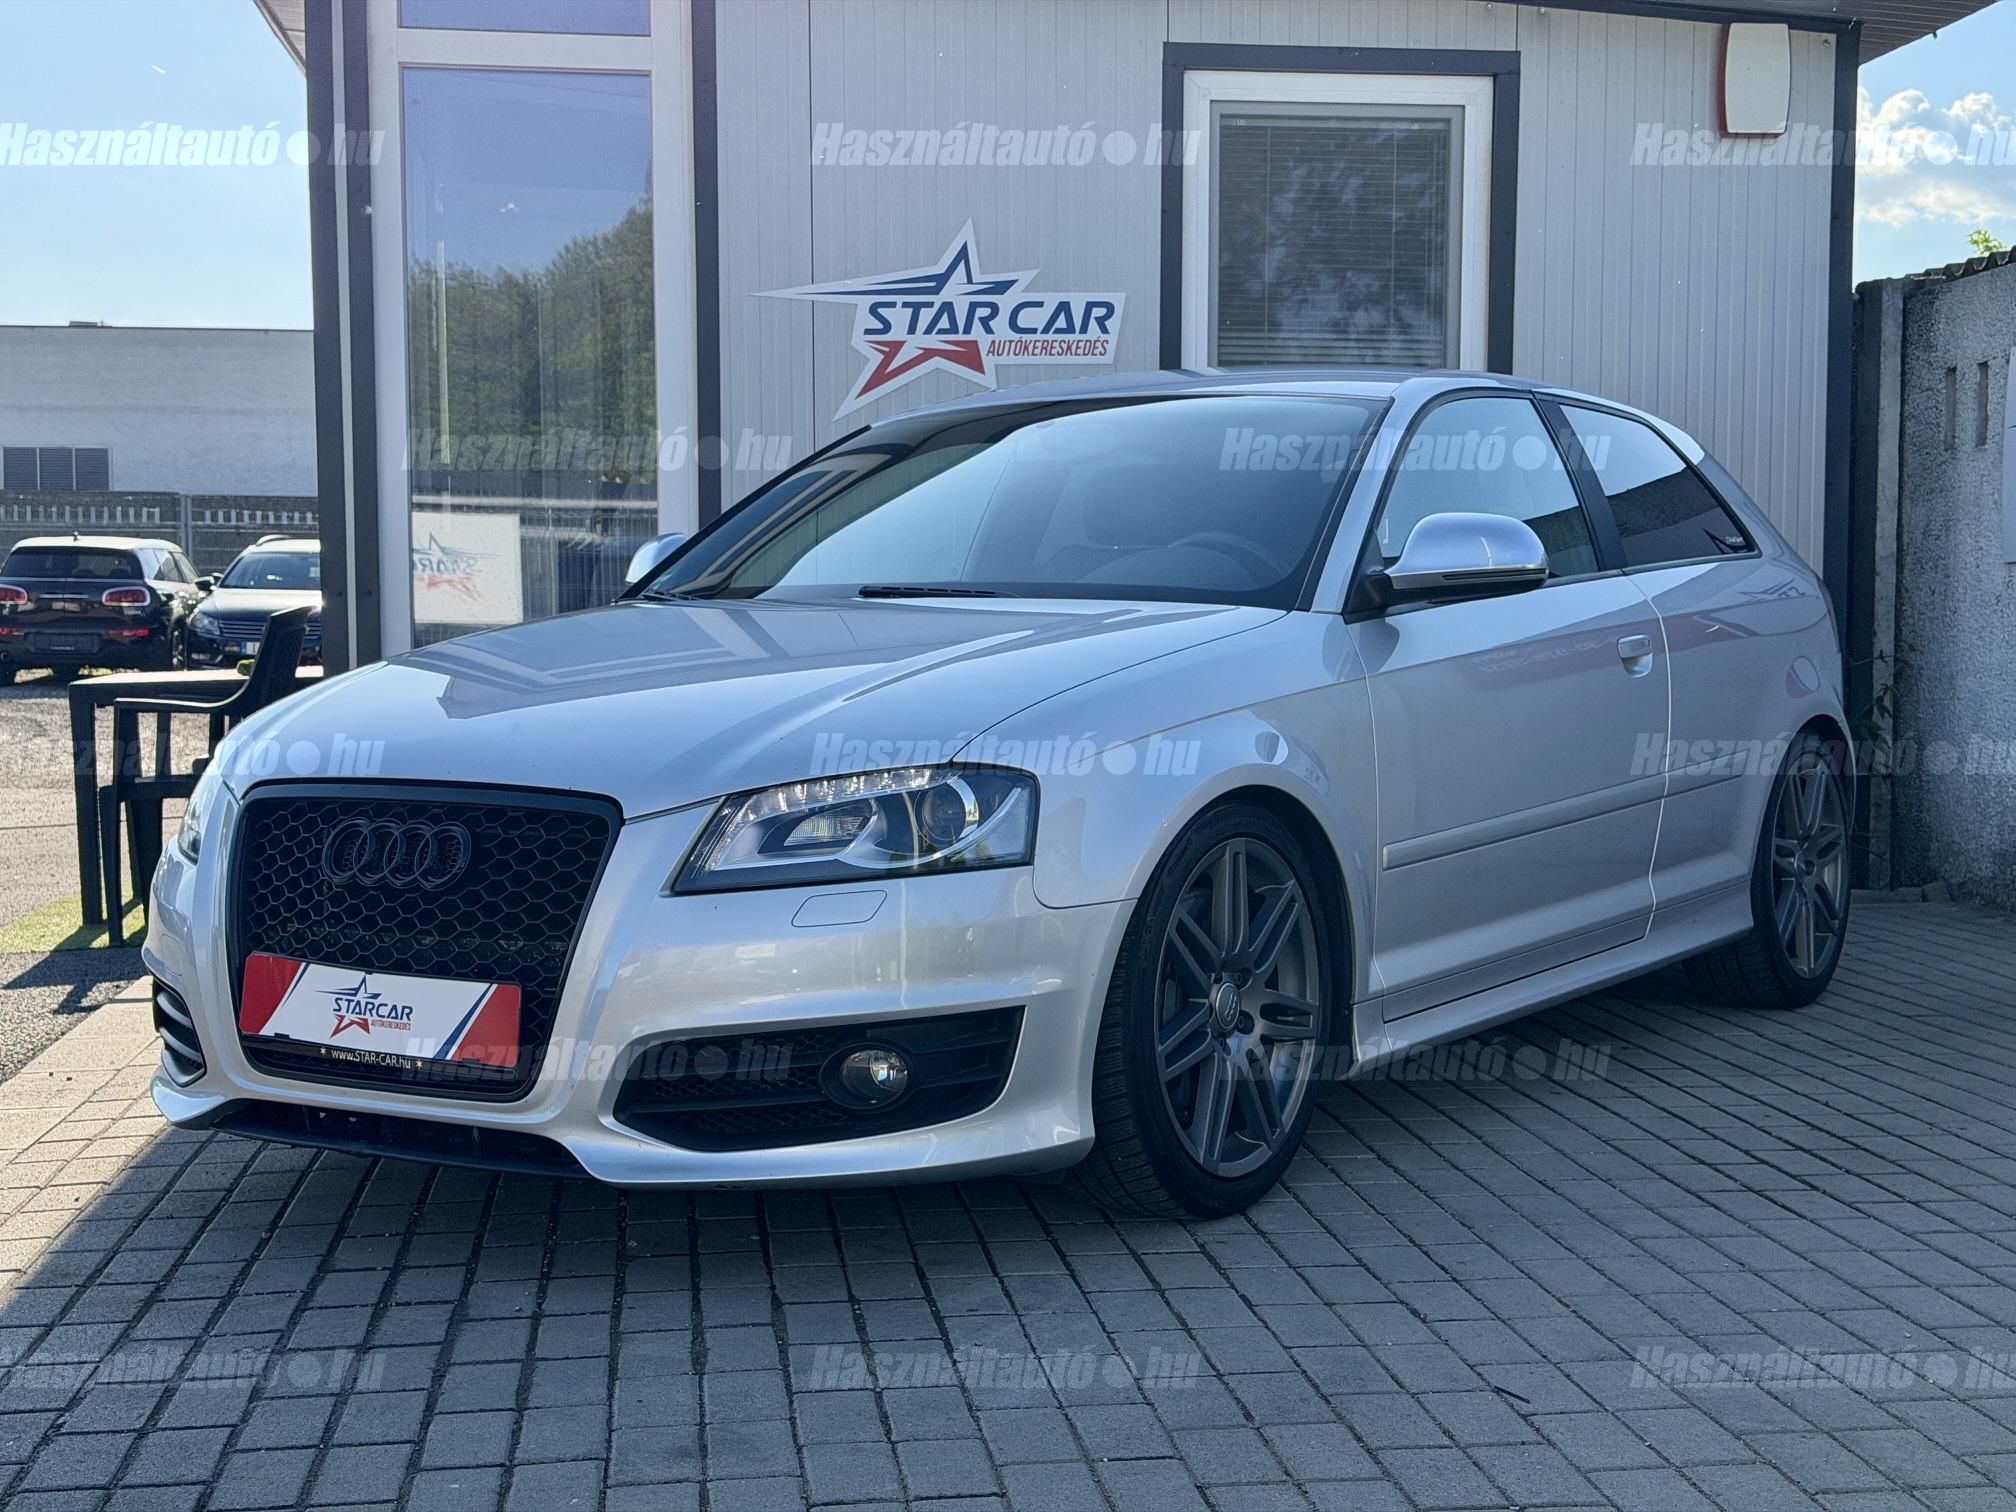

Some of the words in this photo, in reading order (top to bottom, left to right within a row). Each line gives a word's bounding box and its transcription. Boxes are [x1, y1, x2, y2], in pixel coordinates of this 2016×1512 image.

[863, 301, 1000, 336] STAR
[1008, 301, 1116, 335] CAR
[986, 336, 1110, 357] AUTÓKERESKEDÉS
[331, 1049, 411, 1068] www.STAR-CAR.hu
